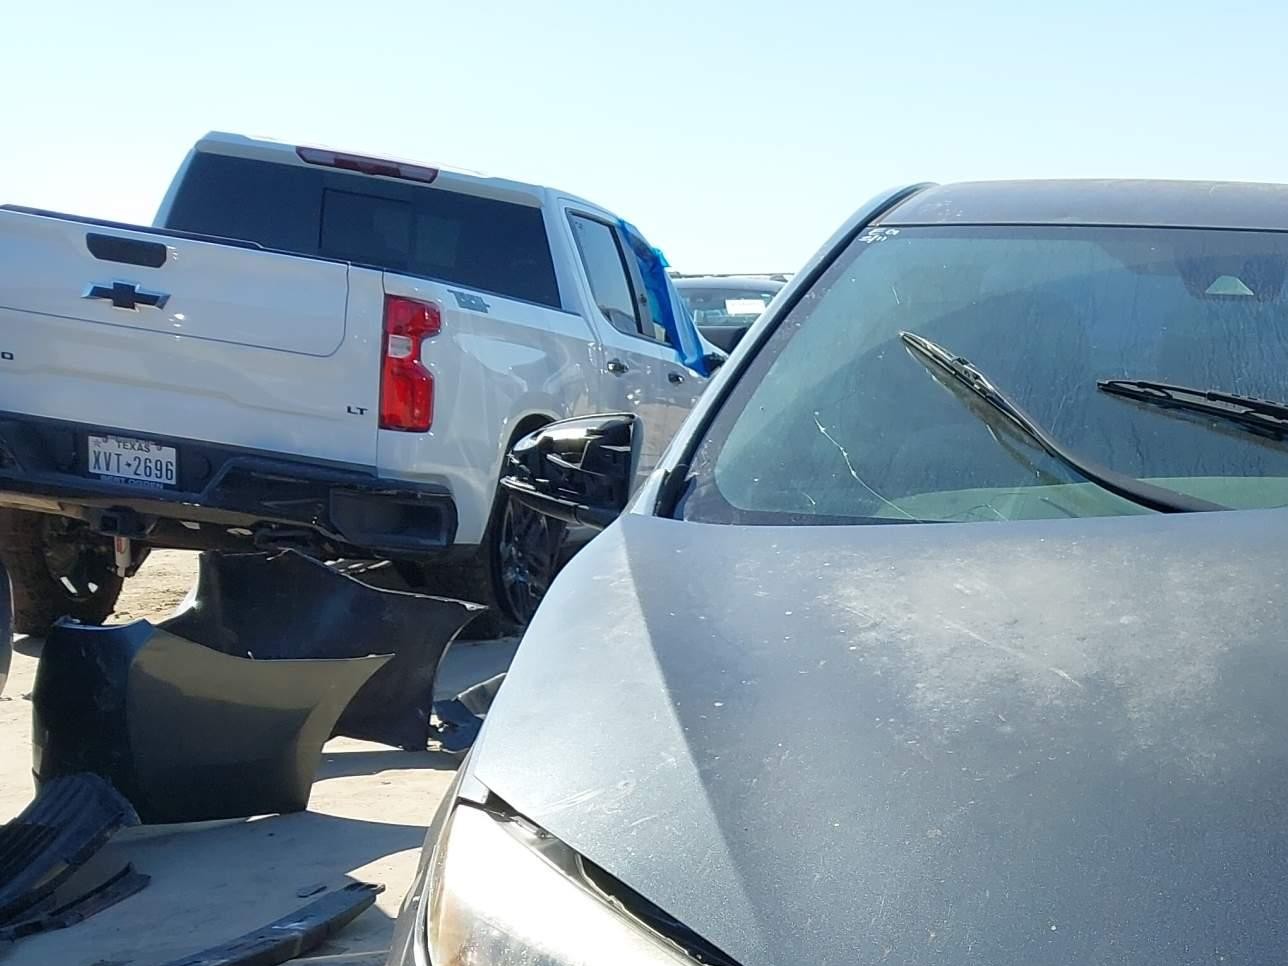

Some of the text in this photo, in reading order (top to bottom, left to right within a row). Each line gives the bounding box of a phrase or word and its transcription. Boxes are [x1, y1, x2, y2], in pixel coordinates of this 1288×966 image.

[347, 405, 369, 416] LT
[116, 440, 151, 453] TEXAS
[93, 450, 173, 480] XVT 2696
